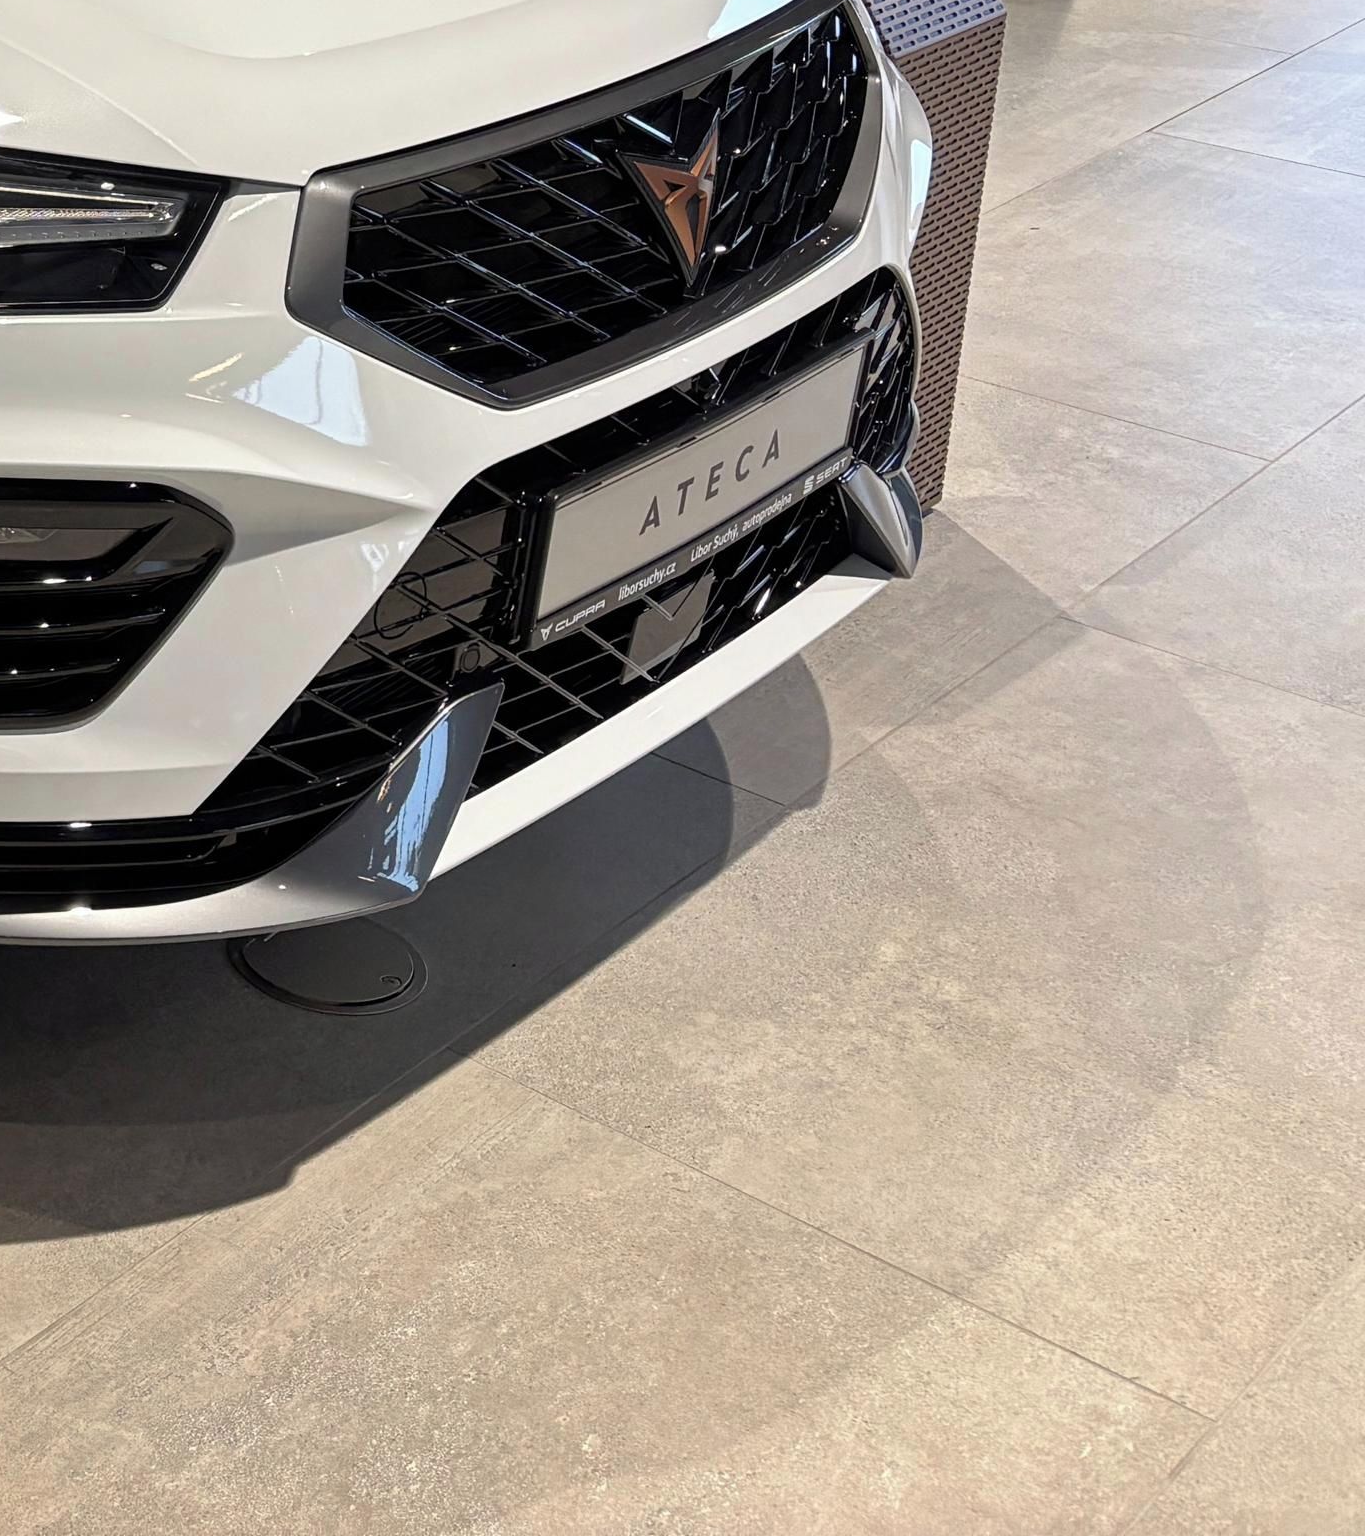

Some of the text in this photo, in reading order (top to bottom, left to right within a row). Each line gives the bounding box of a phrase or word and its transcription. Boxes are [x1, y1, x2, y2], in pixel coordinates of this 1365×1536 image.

[554, 599, 606, 634] CUPRA
[617, 561, 677, 602] liborsuchy.cz
[690, 541, 712, 563] Libor
[741, 492, 793, 531] autoprodejna
[815, 457, 848, 484] SEAT
[638, 429, 780, 536] ATECA
